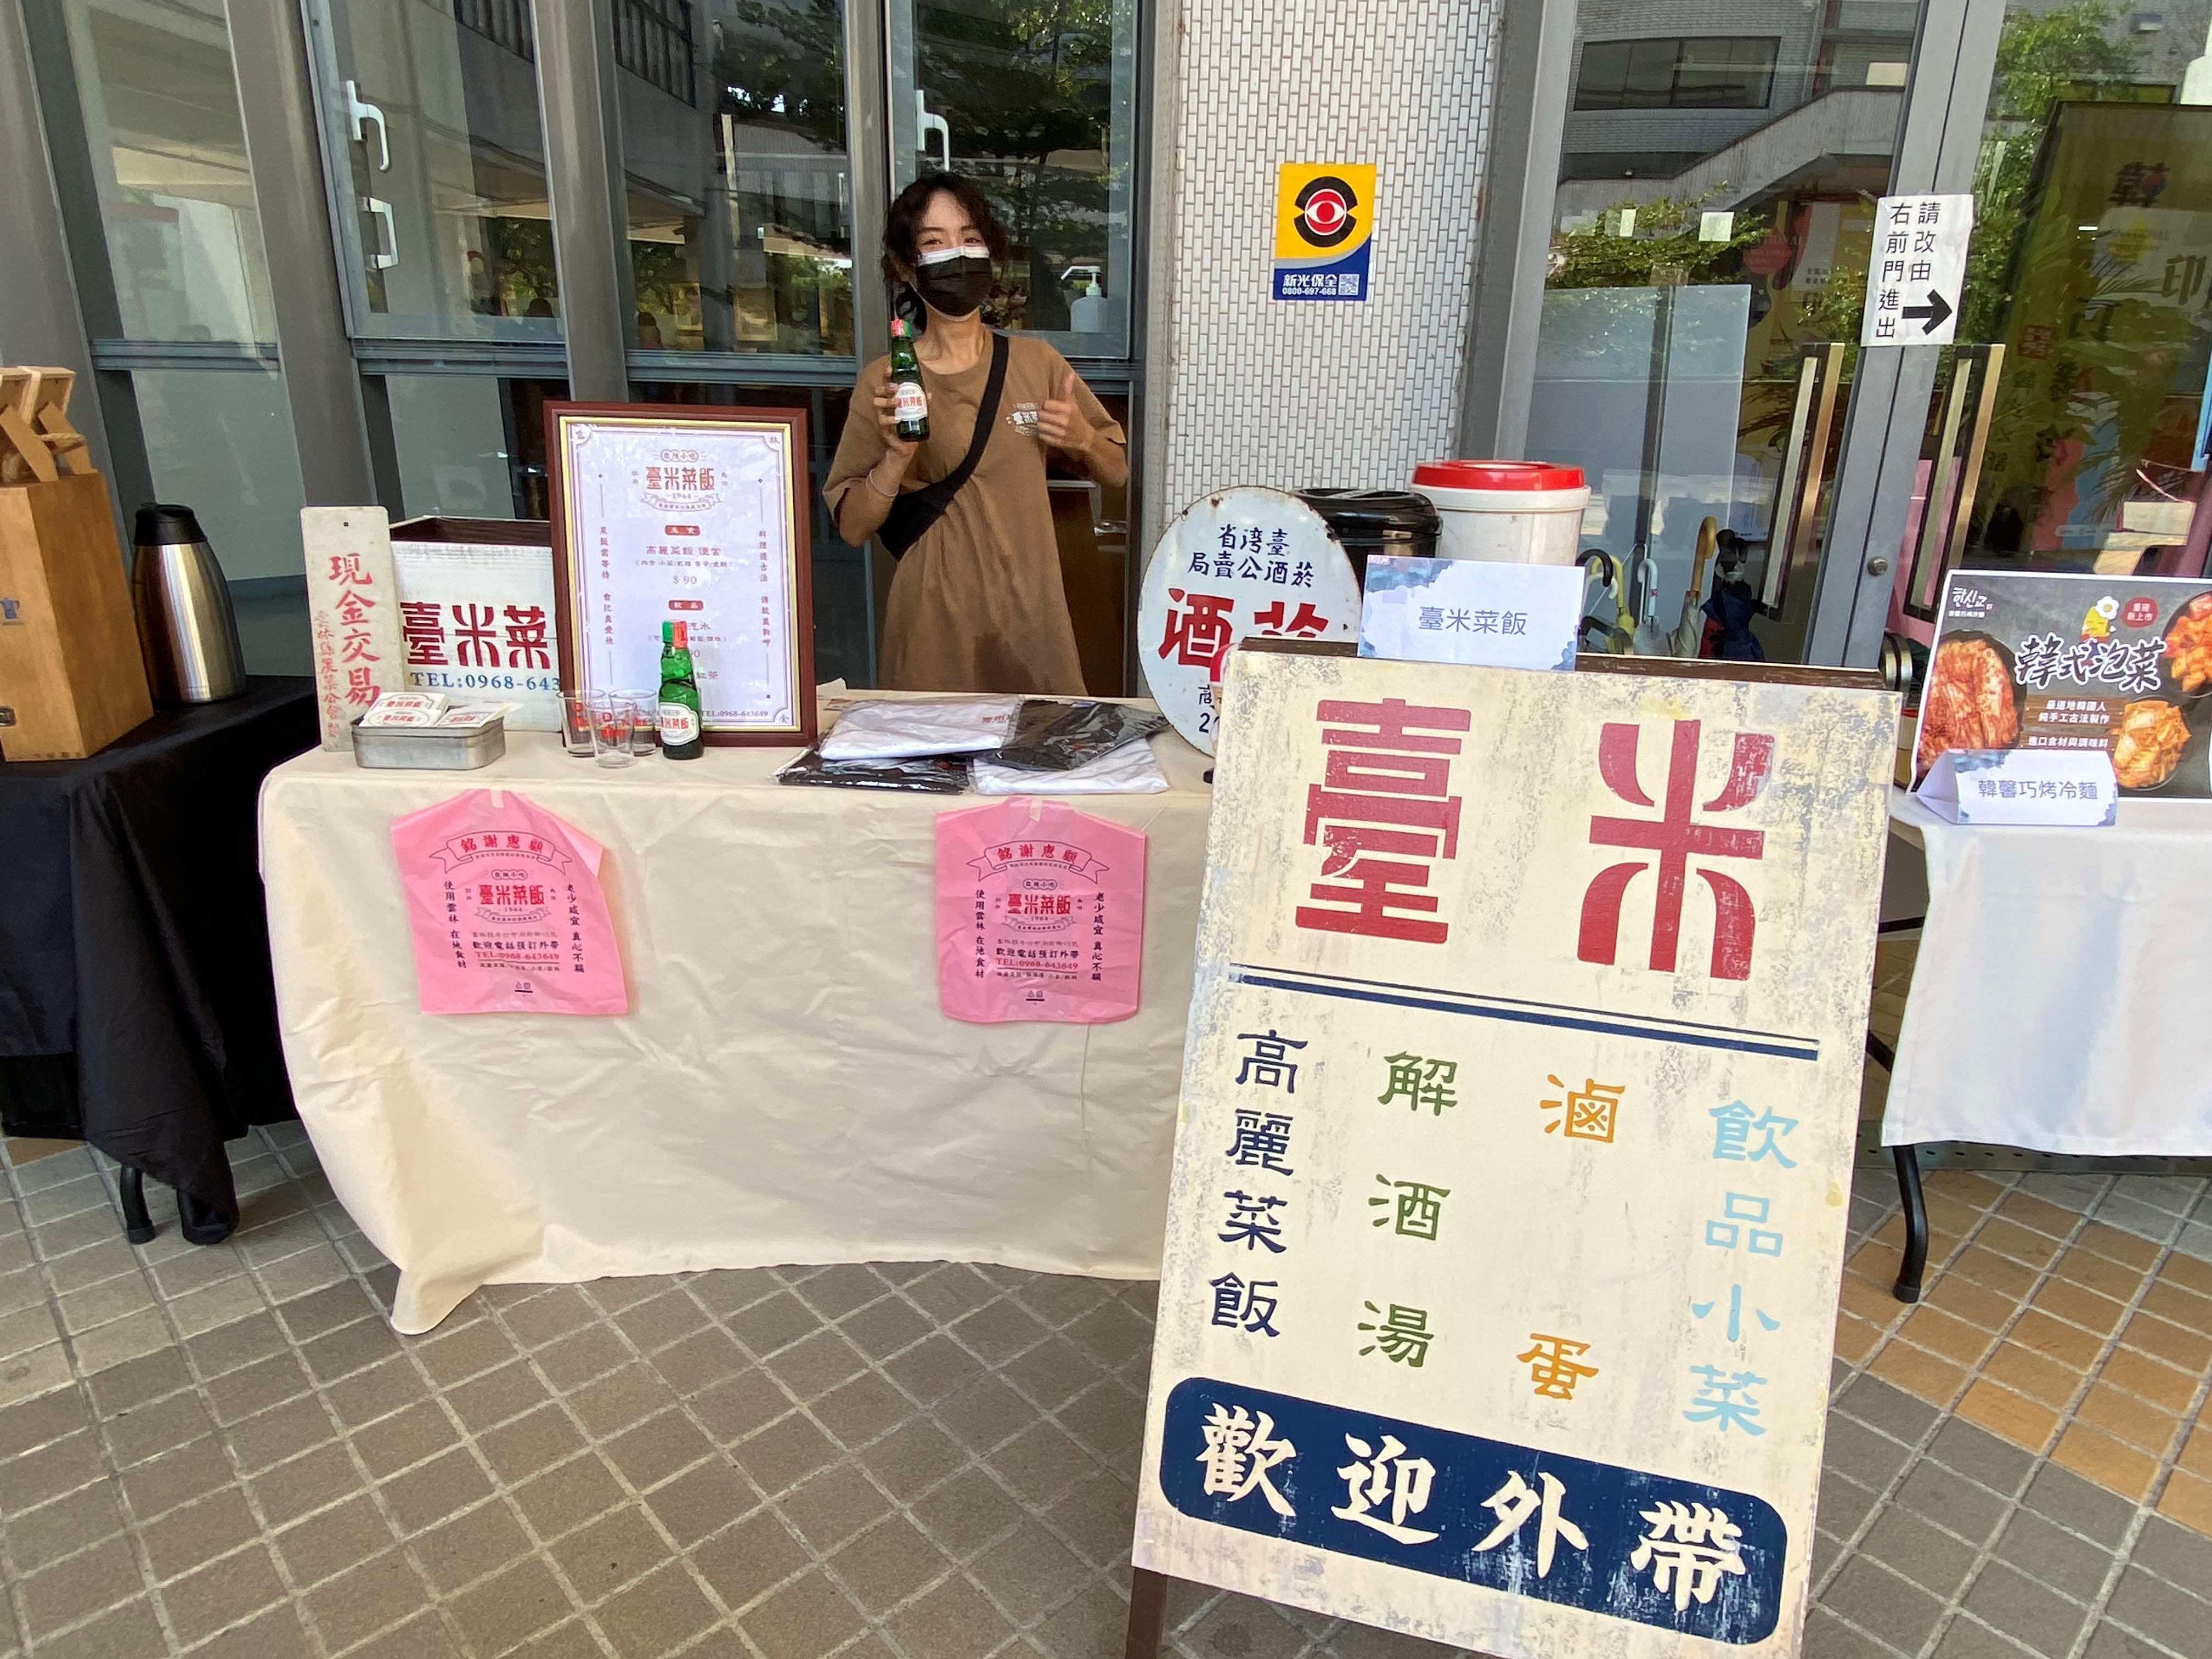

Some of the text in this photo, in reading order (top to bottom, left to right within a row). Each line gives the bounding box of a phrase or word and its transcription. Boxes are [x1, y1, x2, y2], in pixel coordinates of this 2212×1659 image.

[1910, 201, 1941, 282] 請改由
[1283, 274, 1338, 287] 新光保全
[1875, 202, 1912, 338] 右前門進出
[646, 466, 715, 490] 臺米菜飯
[1187, 550, 1314, 588] 菸酒公賣局
[329, 552, 381, 707] 現金交易
[399, 601, 551, 669] 臺米菜
[1418, 606, 1528, 636] 臺米菜飯
[410, 672, 561, 691] TEL:0968-643
[2016, 633, 2167, 692] 韓式泡菜
[2038, 712, 2111, 725] 純手工古法製作
[1978, 780, 2098, 800] 韓馨巧烤冷麵
[460, 834, 543, 854] 銘謝惠顧
[997, 843, 1079, 864] 銘謝惠顧
[1295, 698, 1776, 981] 臺米
[444, 880, 460, 923] 使用雲林
[479, 884, 545, 905] 臺米菜飯
[1007, 894, 1071, 915] 臺米菜飯
[1093, 891, 1105, 935] 老少咸宜
[974, 889, 986, 979] 使用雲林 在地食材
[1210, 1029, 1308, 1338] 高麗菜飯
[1357, 1050, 1458, 1368] 解酒湯
[1517, 1074, 1626, 1401] 滷蛋
[1682, 1099, 1800, 1437] 飲品小菜
[1195, 1402, 1747, 1613] 歡迎外帶
